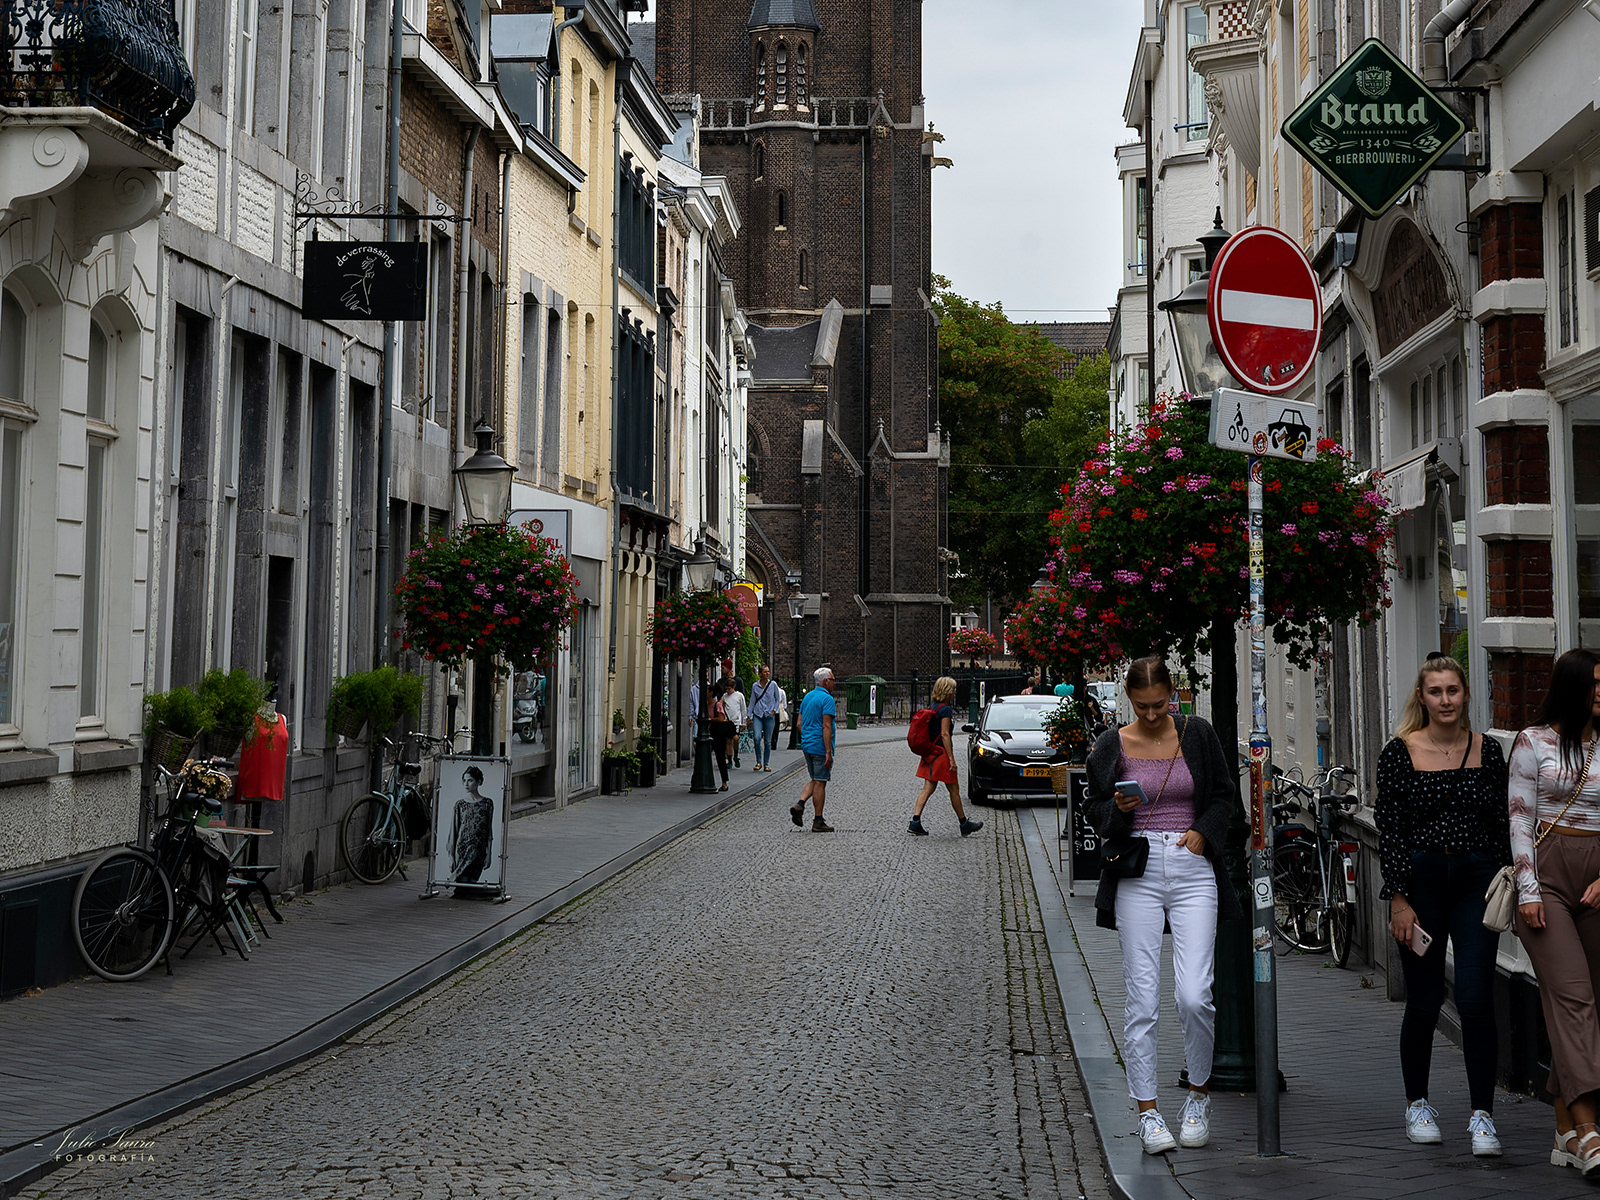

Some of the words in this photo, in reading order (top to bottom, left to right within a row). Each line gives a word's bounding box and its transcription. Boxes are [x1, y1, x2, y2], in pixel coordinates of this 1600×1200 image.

[1321, 93, 1430, 130] Brand
[1360, 139, 1390, 149] 1340
[1335, 152, 1416, 164] BIERBROUWERIJ
[336, 255, 348, 267] de
[347, 246, 395, 268] verrassing
